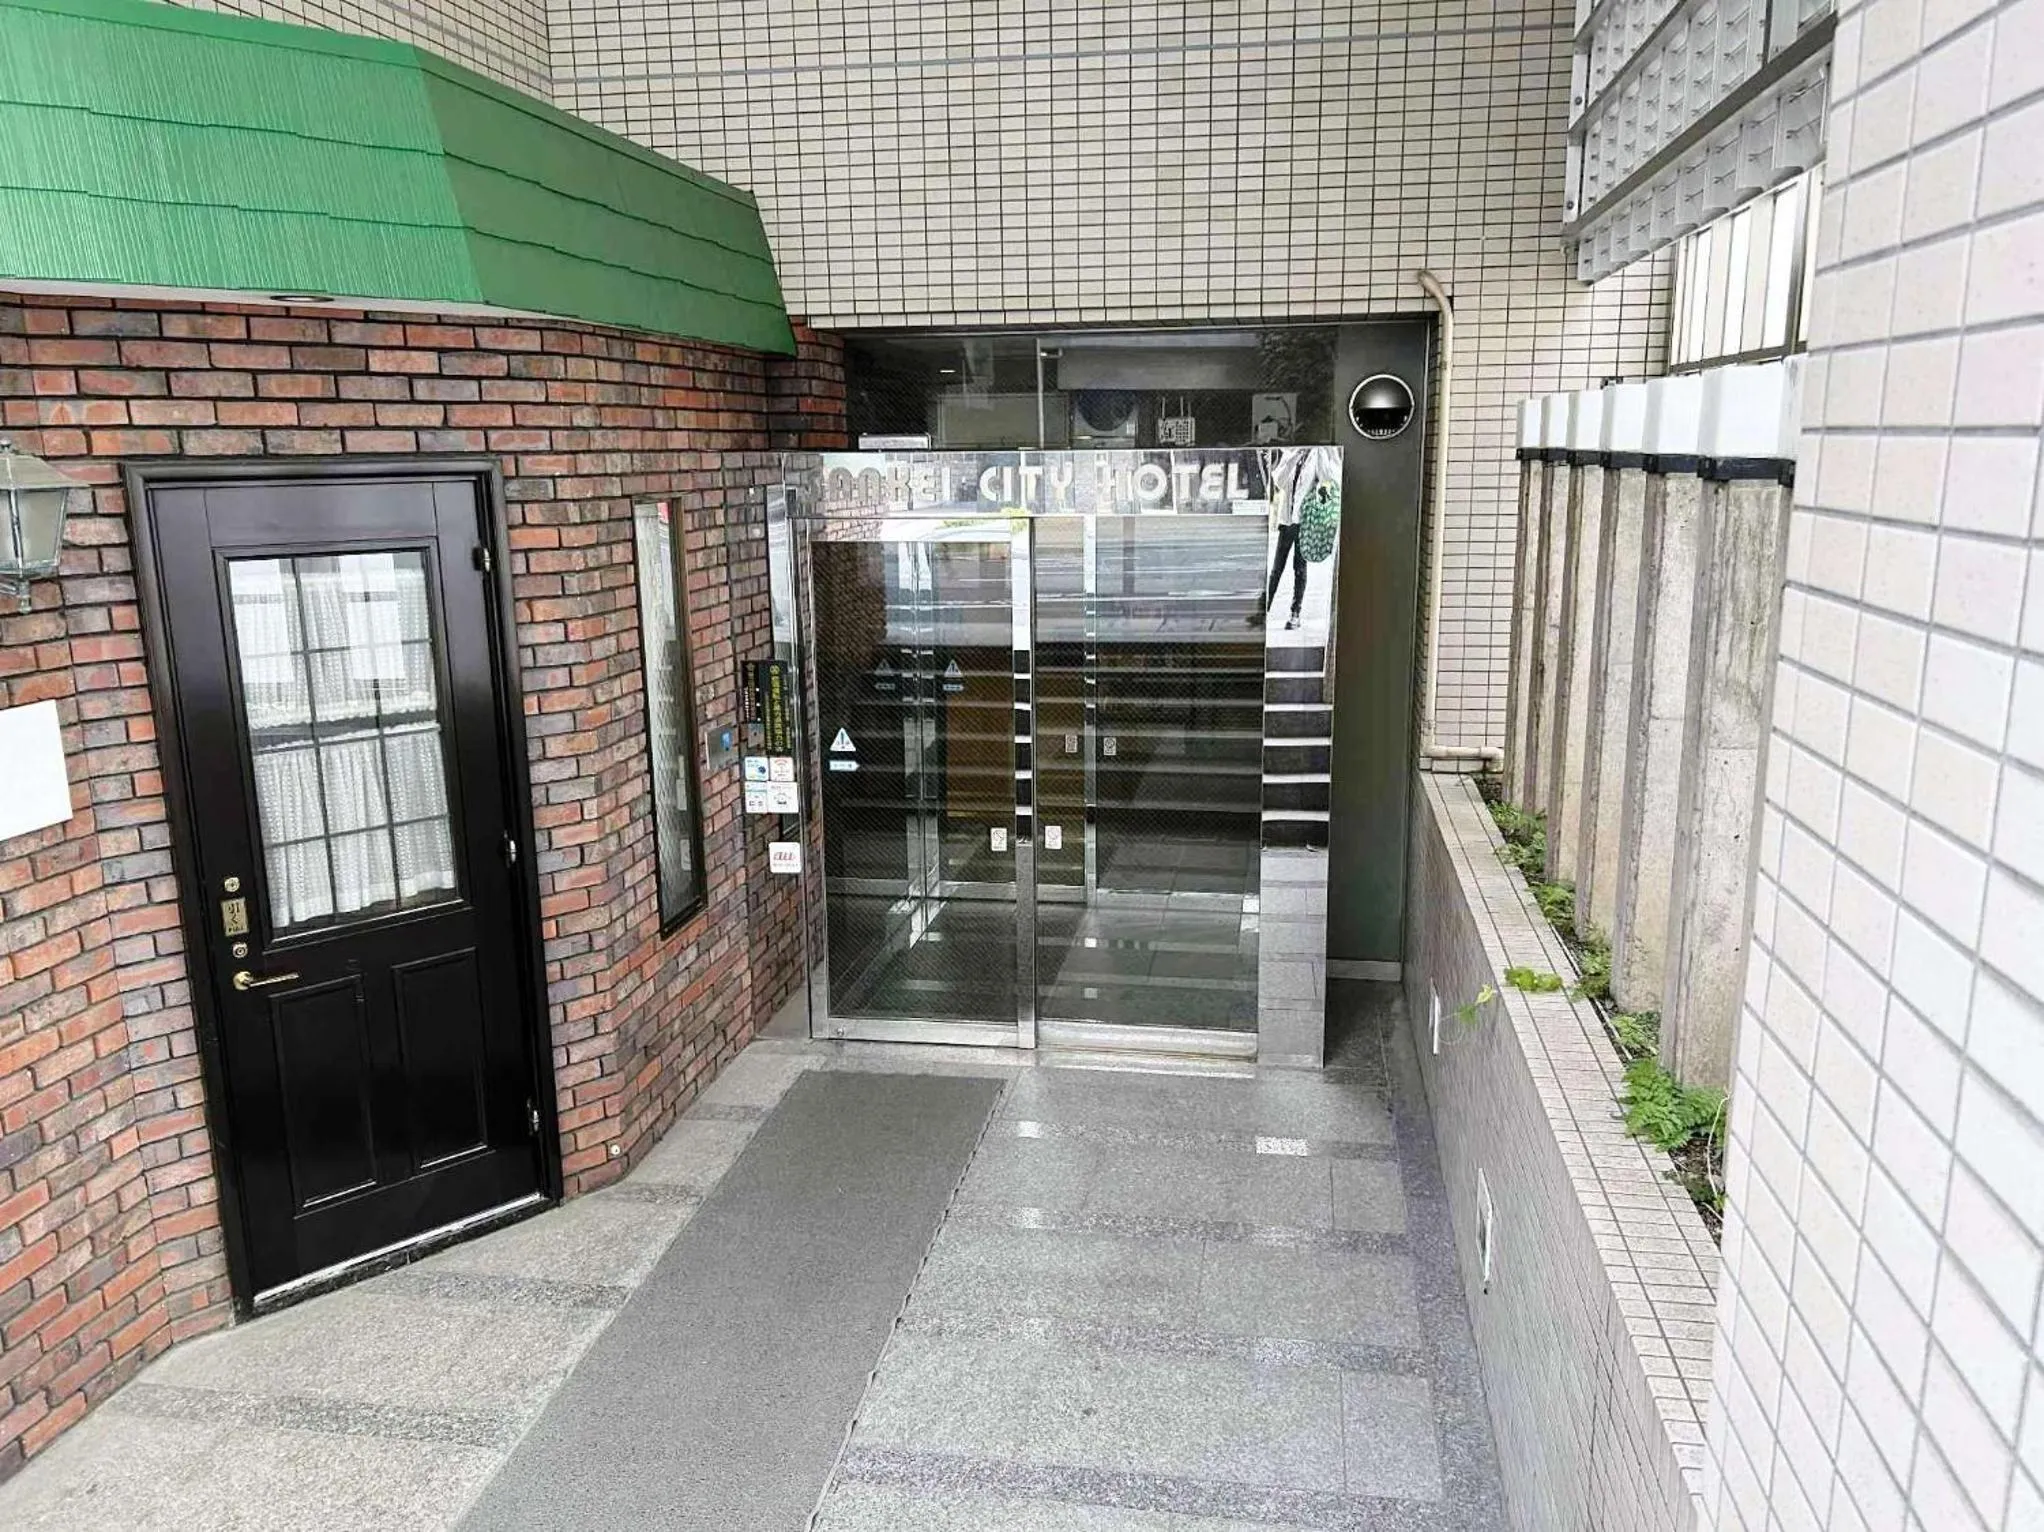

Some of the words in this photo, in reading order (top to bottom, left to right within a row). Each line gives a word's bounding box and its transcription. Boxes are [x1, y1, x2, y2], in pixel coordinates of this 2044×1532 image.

[801, 464, 949, 503] ANKEI
[979, 465, 1073, 503] CITY
[1096, 462, 1249, 502] HOTEL
